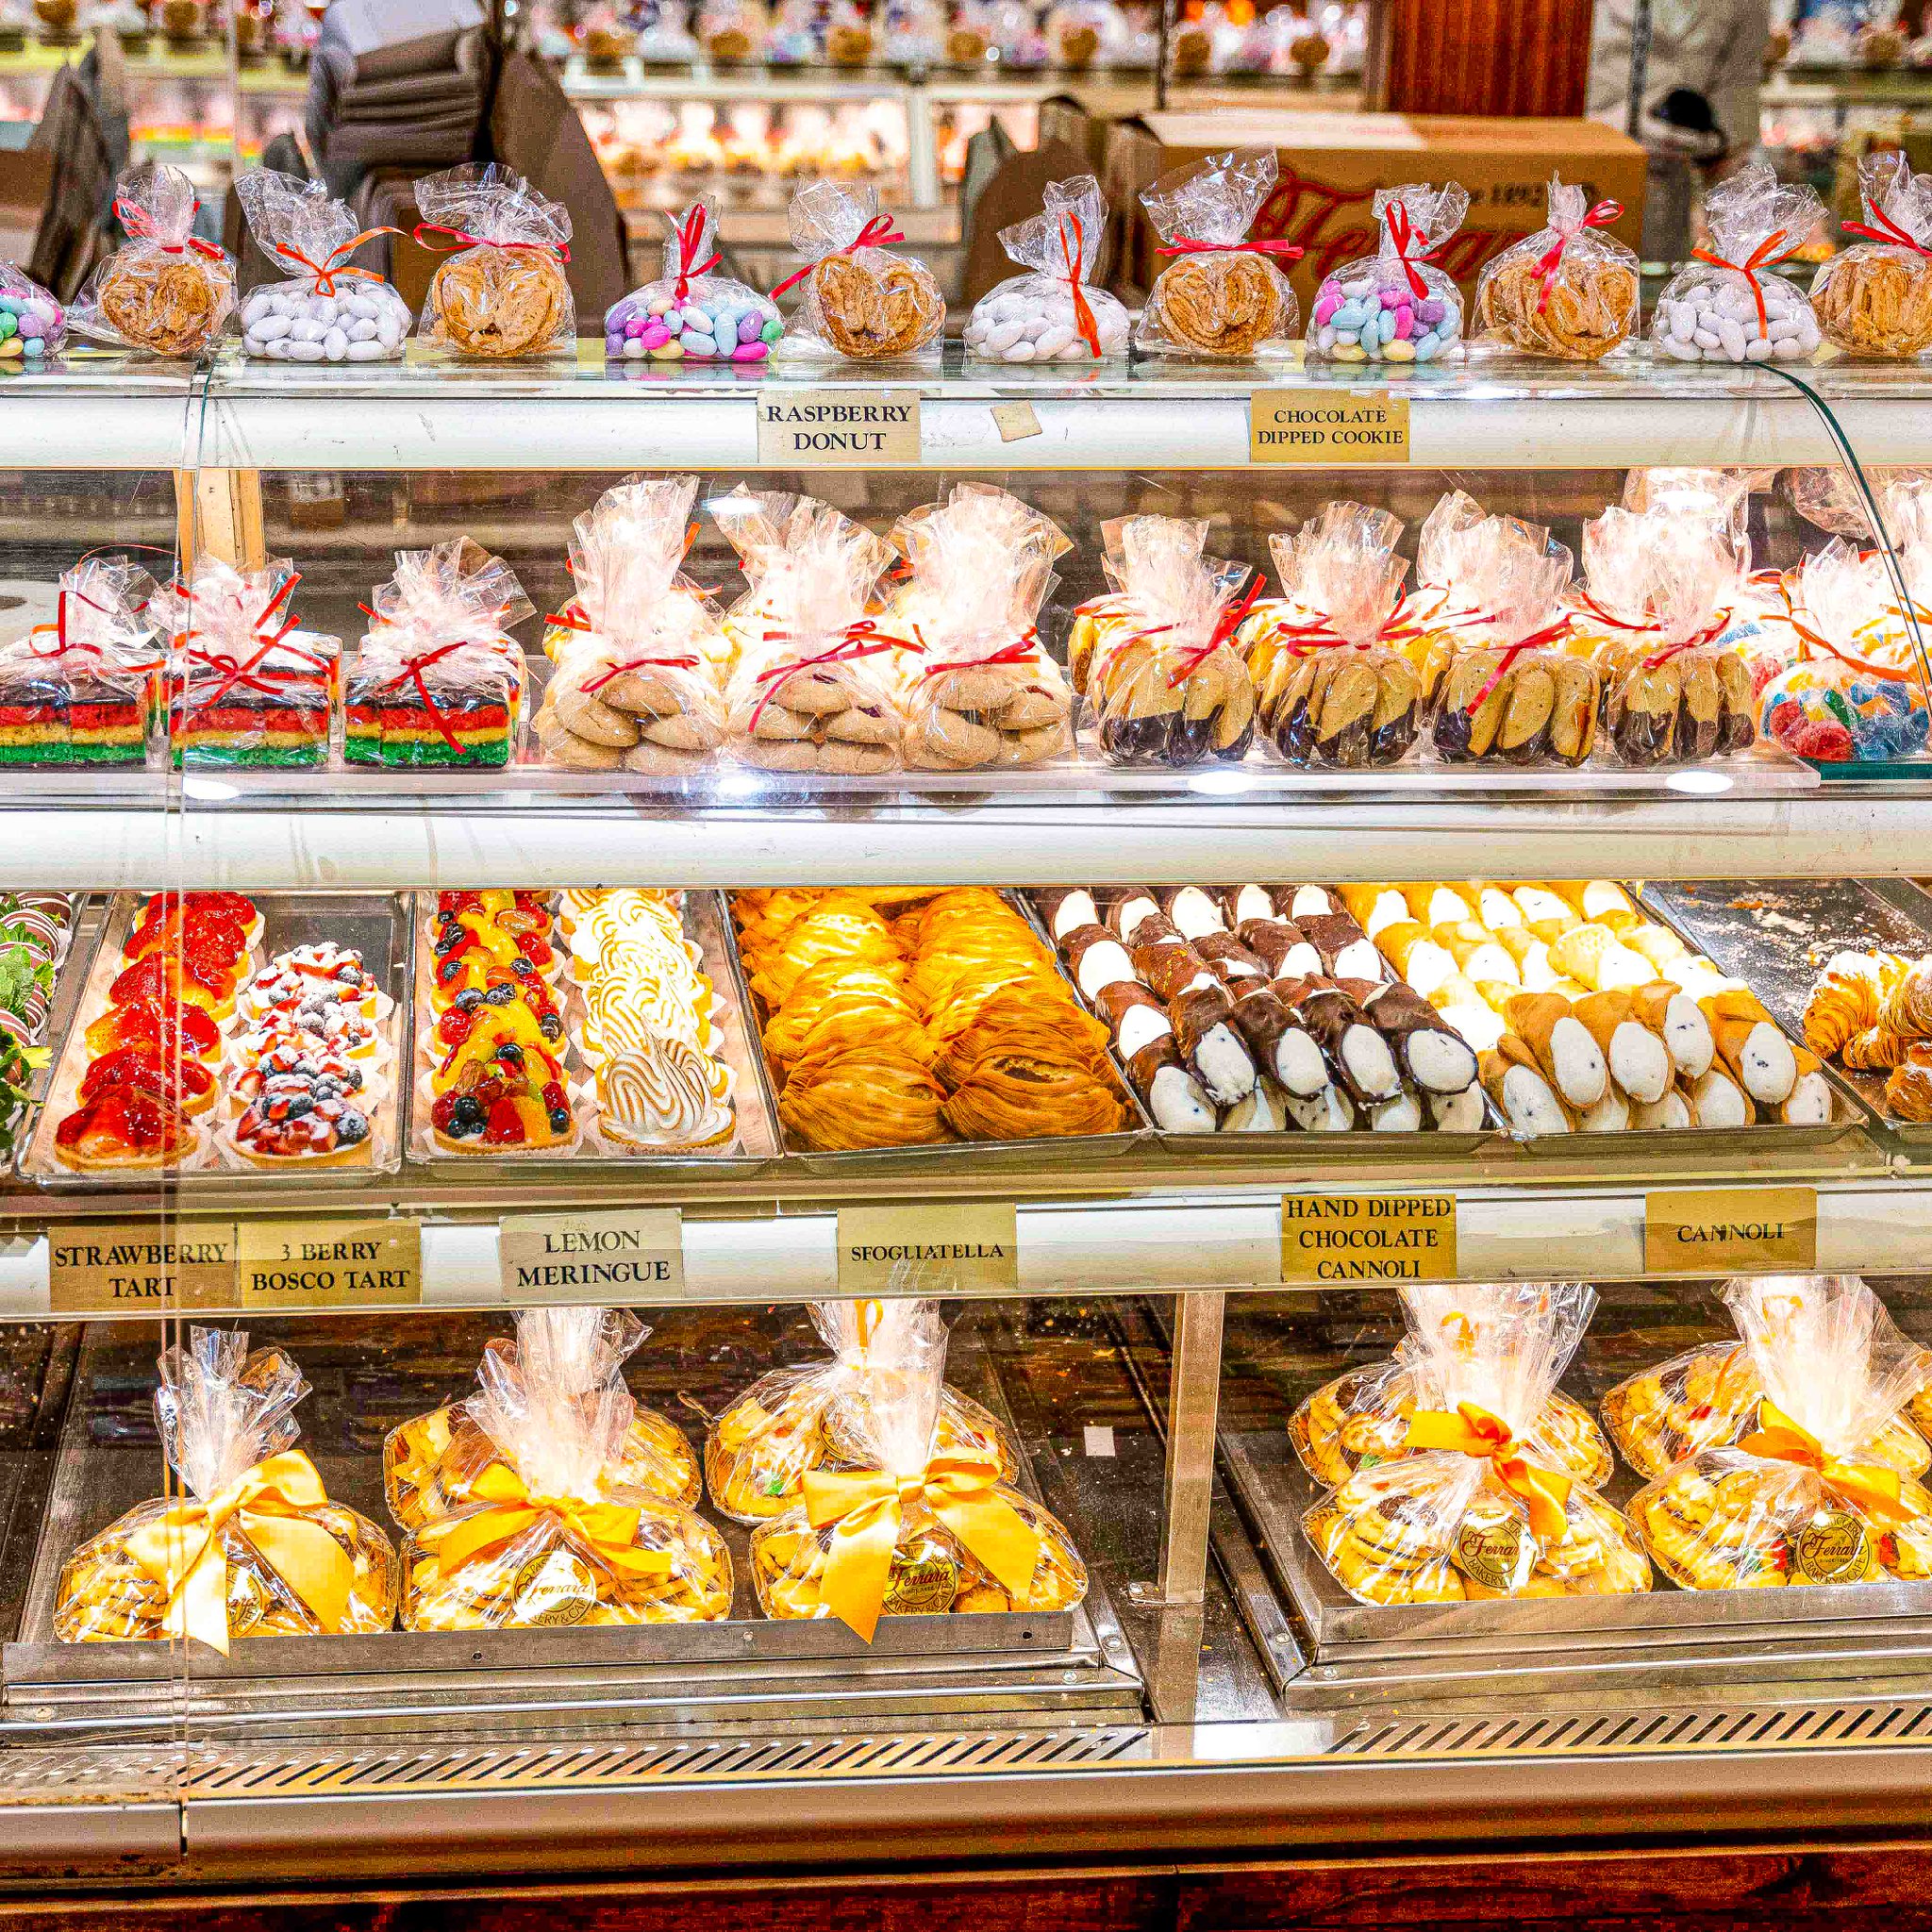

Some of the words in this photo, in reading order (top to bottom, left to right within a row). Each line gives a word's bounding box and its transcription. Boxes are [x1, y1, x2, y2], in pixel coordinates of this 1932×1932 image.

[766, 405, 912, 423] RASPBERRY
[1273, 408, 1388, 424] CHOCOLATE
[792, 432, 887, 451] DONUT
[1257, 430, 1325, 444] DIPPED
[1331, 430, 1405, 444] COOKIE
[1287, 1199, 1358, 1218] HAND
[1367, 1198, 1451, 1217] DIPPED
[542, 1230, 641, 1254] LEMON
[1298, 1228, 1439, 1249] CHOCOLATE
[1677, 1223, 1785, 1242] CANNOLI
[54, 1242, 228, 1267] STRAWBERRY
[280, 1243, 291, 1262] 3
[300, 1241, 382, 1261] BERRY
[851, 1243, 1005, 1261] SFOGLIATELLA
[516, 1260, 671, 1287] MERINGUE
[1317, 1259, 1422, 1279] CANNOLI
[108, 1276, 177, 1298] TART
[251, 1272, 335, 1291] BOSCO
[343, 1270, 411, 1290] TART
